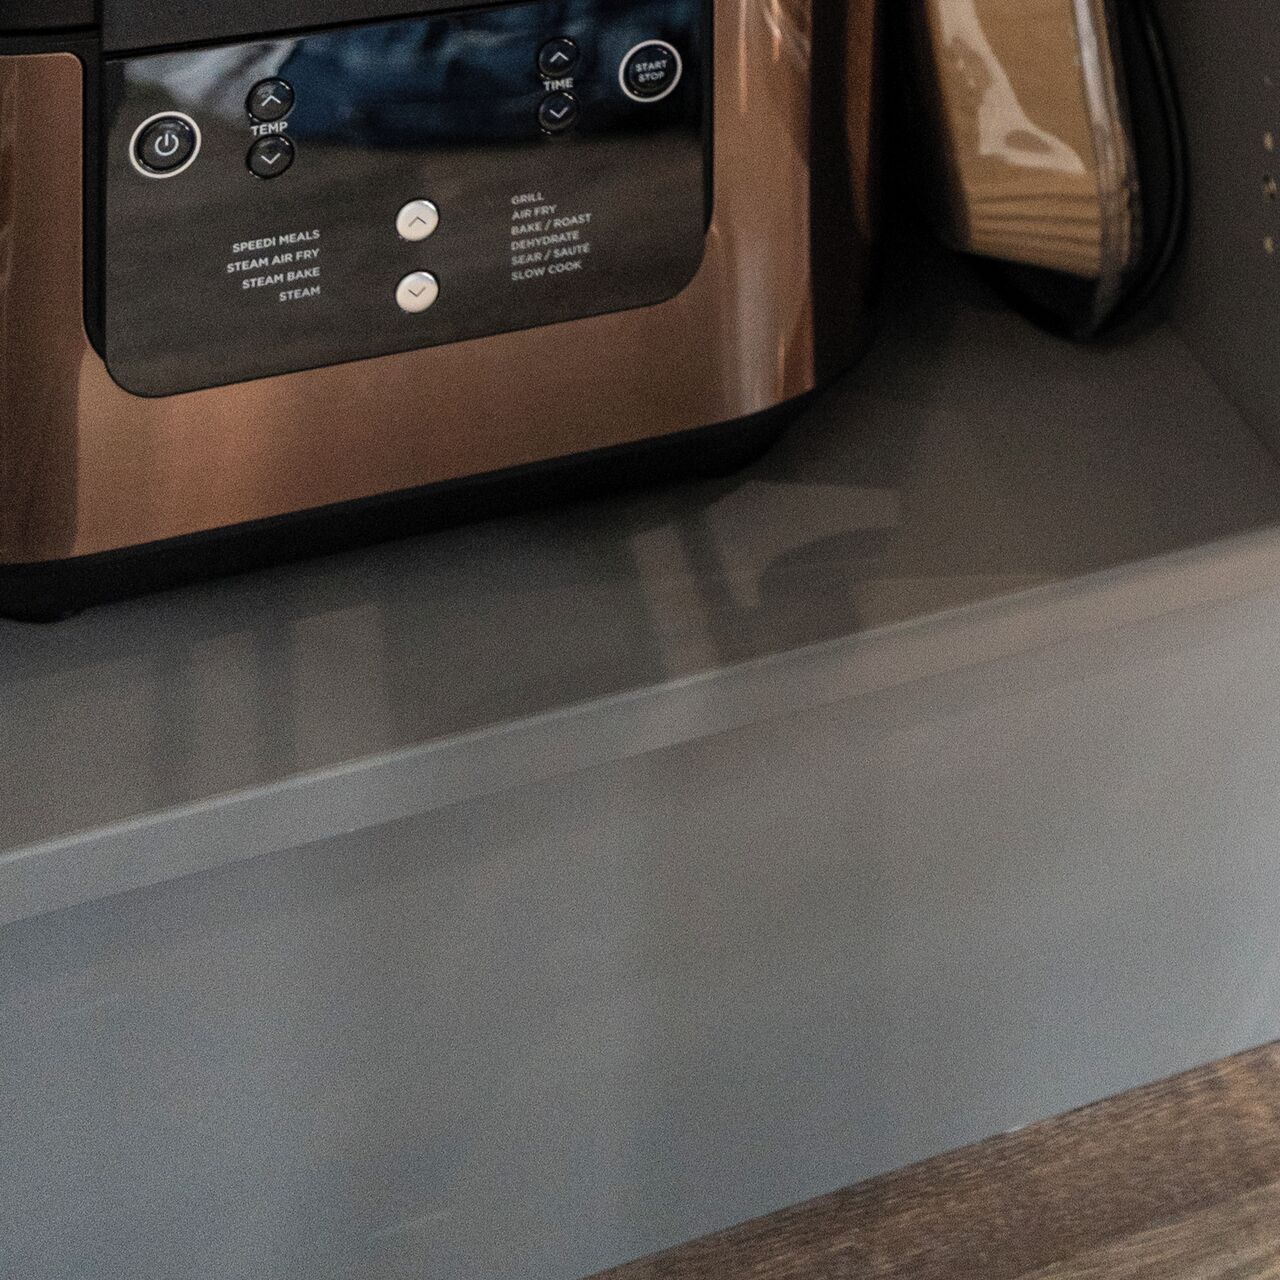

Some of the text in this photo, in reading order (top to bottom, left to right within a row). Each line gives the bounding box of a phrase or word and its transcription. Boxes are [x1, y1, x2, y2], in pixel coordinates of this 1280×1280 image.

[635, 60, 667, 72] START
[542, 77, 574, 91] TIME
[638, 70, 665, 83] STOP
[250, 121, 288, 136] TEMP
[512, 204, 557, 220] AIR FRY
[511, 221, 542, 236] BAKE
[553, 213, 591, 228] ROAST
[232, 229, 320, 253] SPEEDI MEALS
[511, 230, 580, 251] DEHYDRATE
[226, 248, 320, 273] STEAM AIR FRY
[511, 251, 543, 266] SEAR
[242, 266, 320, 290] STEAM BAKE
[511, 260, 582, 280] SLOW COOK
[280, 285, 321, 302] STEAM
